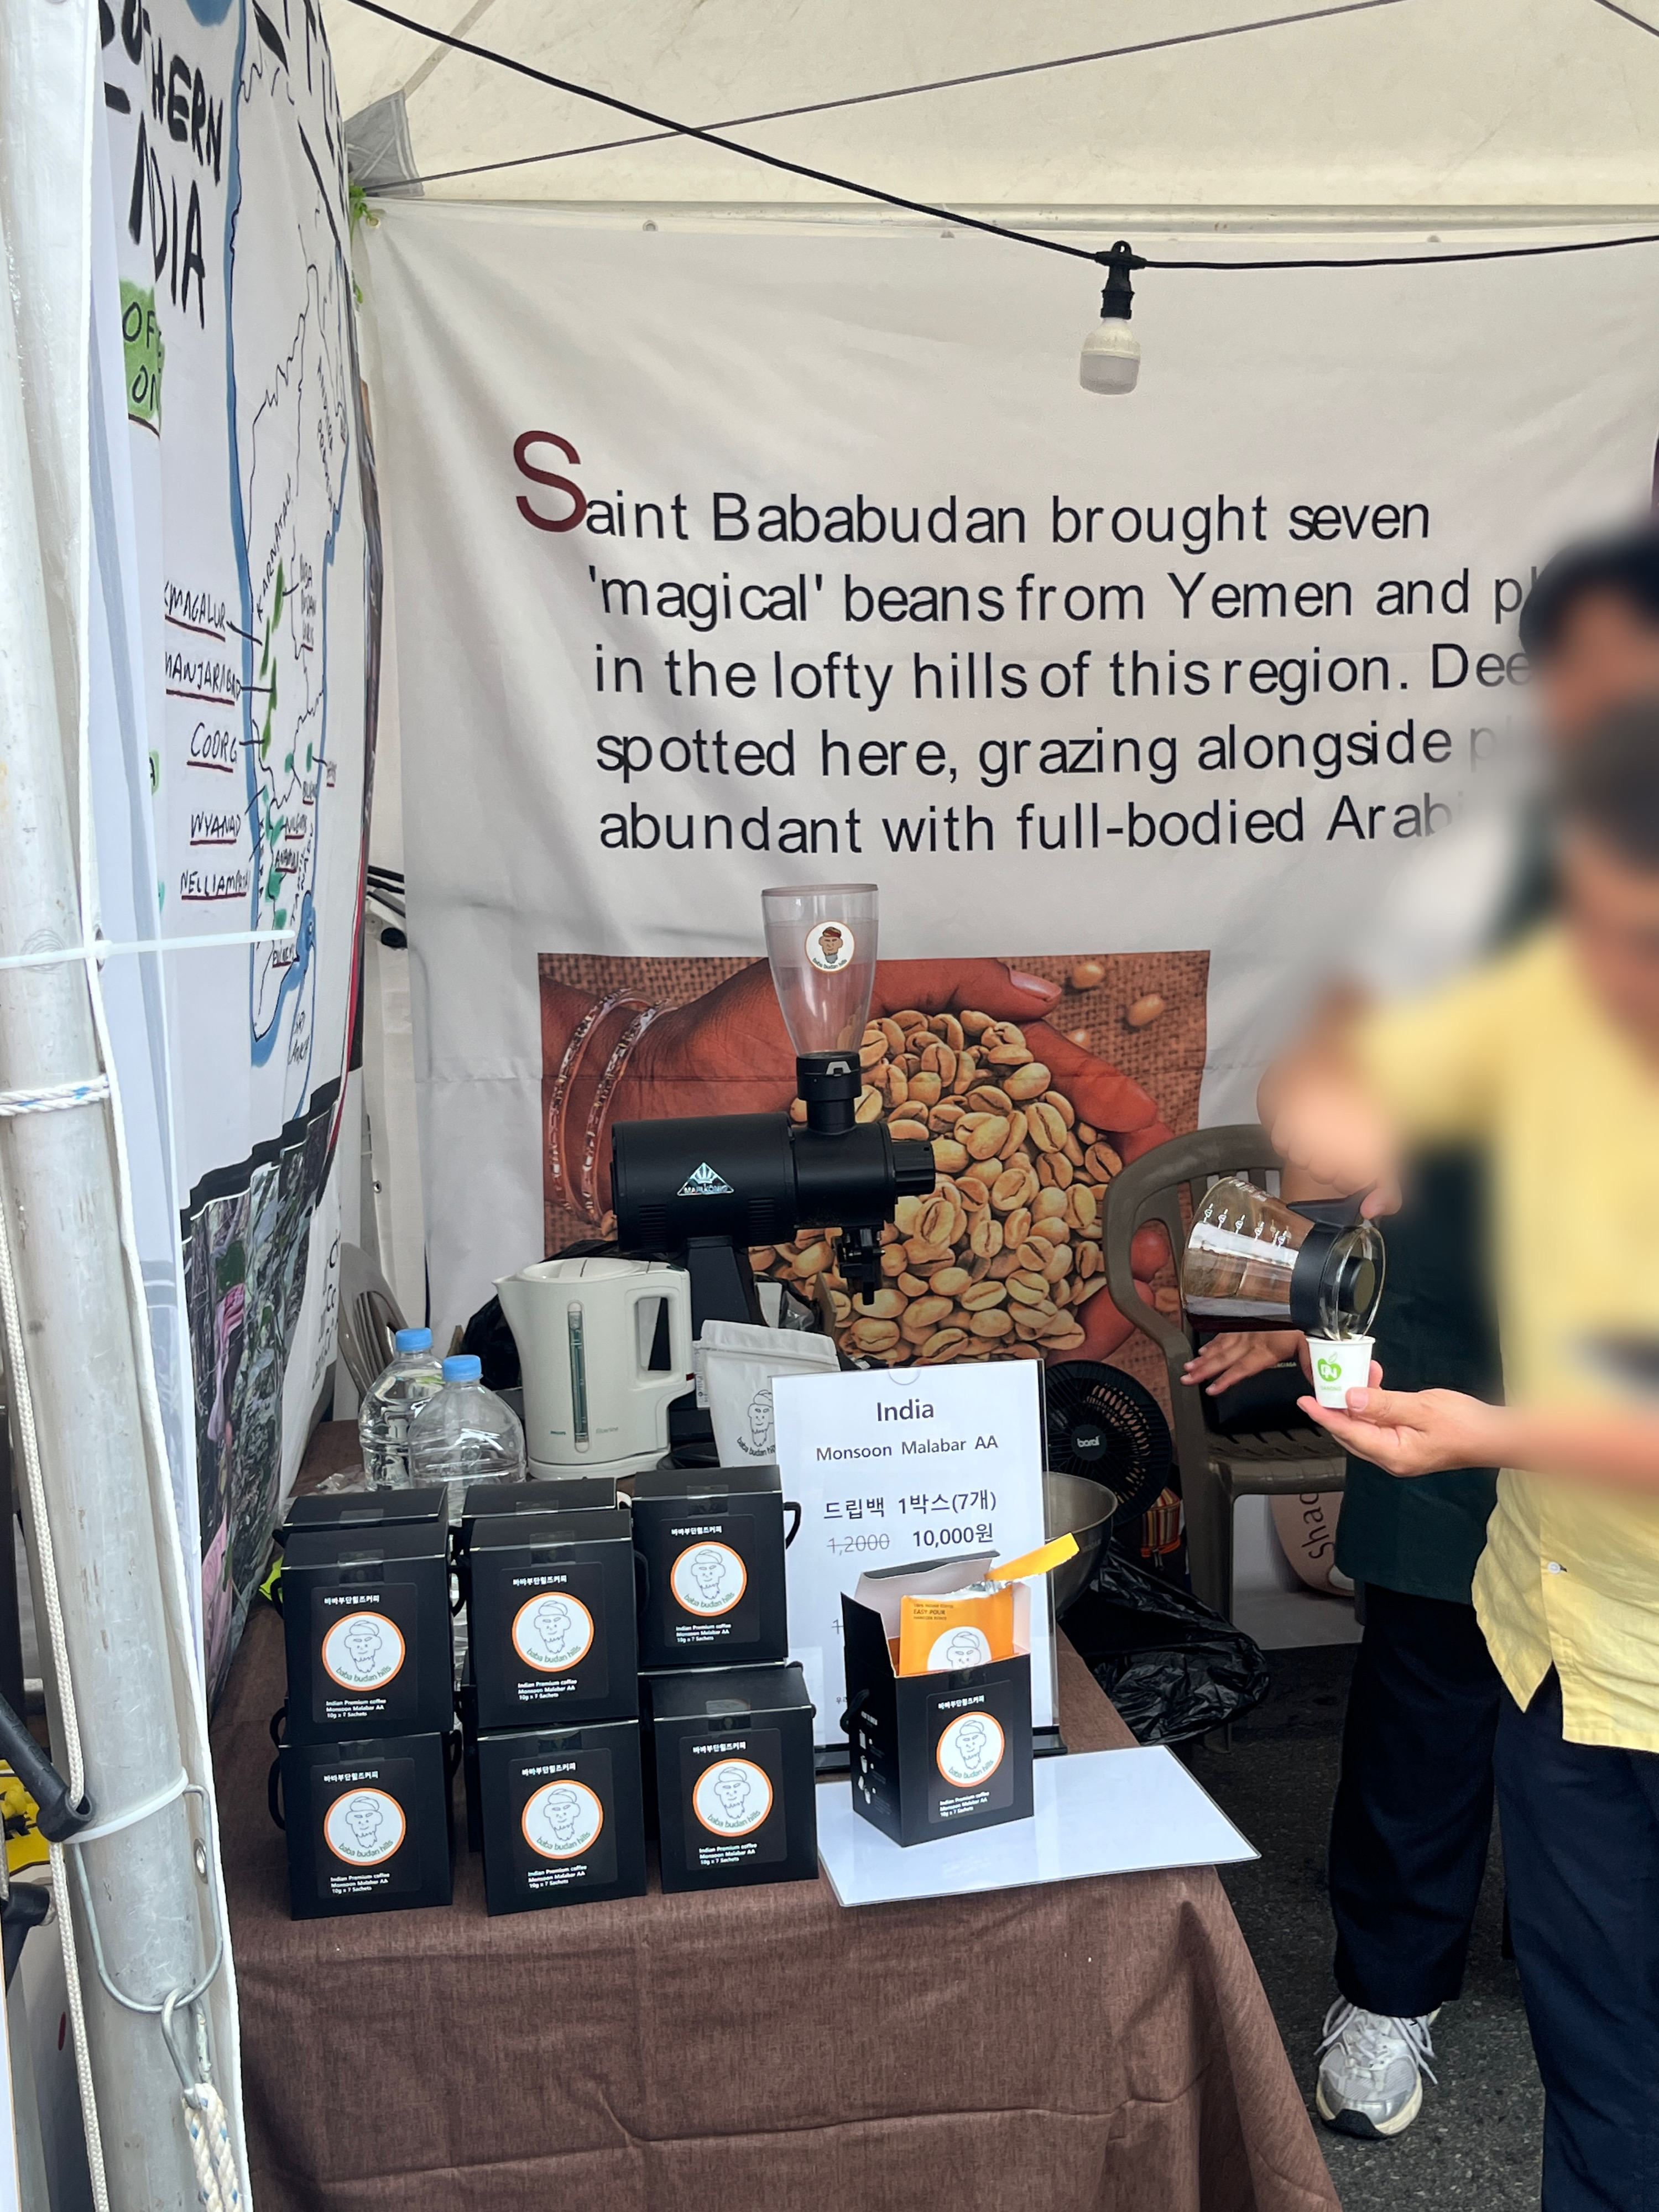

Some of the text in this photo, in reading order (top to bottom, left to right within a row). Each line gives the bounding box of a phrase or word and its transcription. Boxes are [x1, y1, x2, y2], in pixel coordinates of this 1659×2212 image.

[513, 431, 1428, 554] Saint Bababudan brought seven
[589, 565, 822, 632] 'magical'
[845, 574, 1004, 622] beans
[1016, 573, 1143, 620] from
[1167, 572, 1351, 618] Yemen
[1377, 568, 1468, 615] and
[597, 644, 643, 692] in
[665, 649, 755, 698] the
[775, 651, 893, 712] lofty
[915, 653, 1027, 698] hills
[1041, 650, 1091, 697] of
[1110, 650, 1209, 696] this
[1225, 647, 1407, 705] region.
[191, 722, 237, 763] COORG
[597, 729, 794, 783] spotted
[822, 729, 956, 783] here,
[980, 727, 1176, 787] grazing
[1199, 719, 1451, 779] alongside
[191, 811, 241, 838] WYANAD
[601, 802, 862, 853] abundant
[882, 805, 993, 852] with
[1017, 797, 1303, 849] full-bodied
[877, 1399, 935, 1421] India
[816, 1434, 999, 1461] Monsoon Malabar AA
[823, 1489, 997, 1519] 드립백 1박스(7개)
[912, 1522, 993, 1548] 10,000원
[526, 1648, 543, 1662] baba
[336, 1667, 352, 1681] baba
